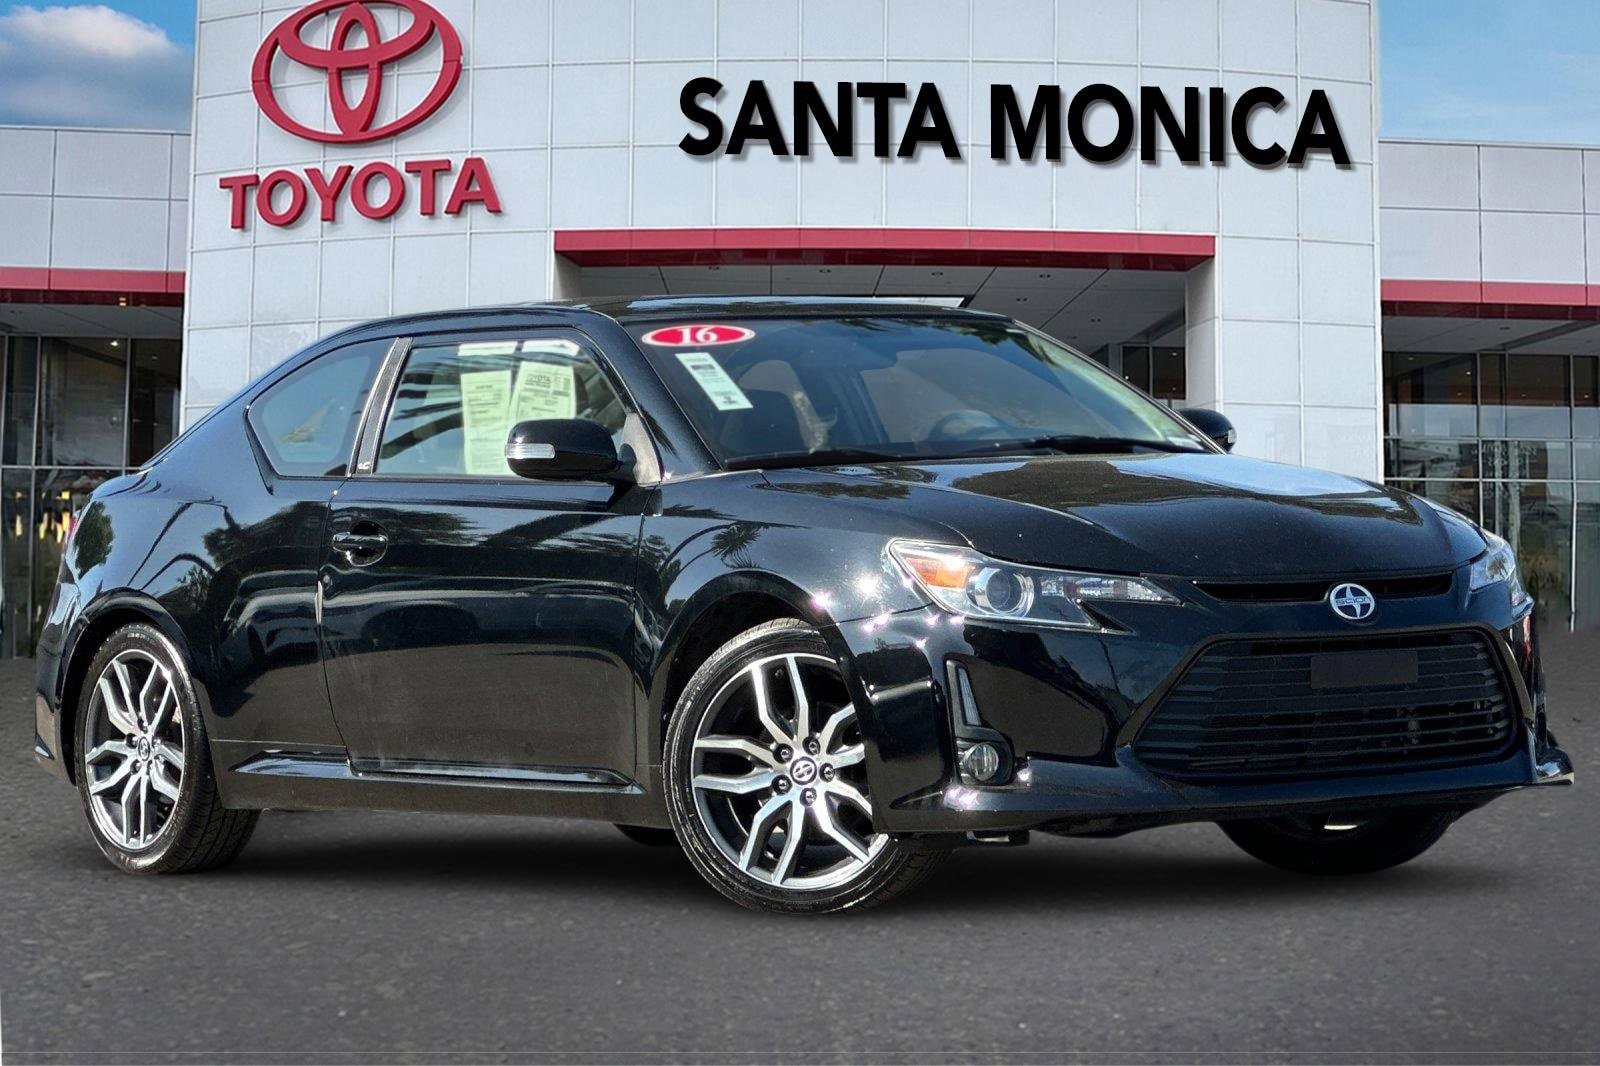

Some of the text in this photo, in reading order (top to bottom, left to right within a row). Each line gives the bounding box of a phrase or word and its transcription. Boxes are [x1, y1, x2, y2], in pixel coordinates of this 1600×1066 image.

[679, 77, 1351, 167] SANTA MONICA
[219, 157, 502, 229] TOYOTA
[676, 326, 719, 345] 16
